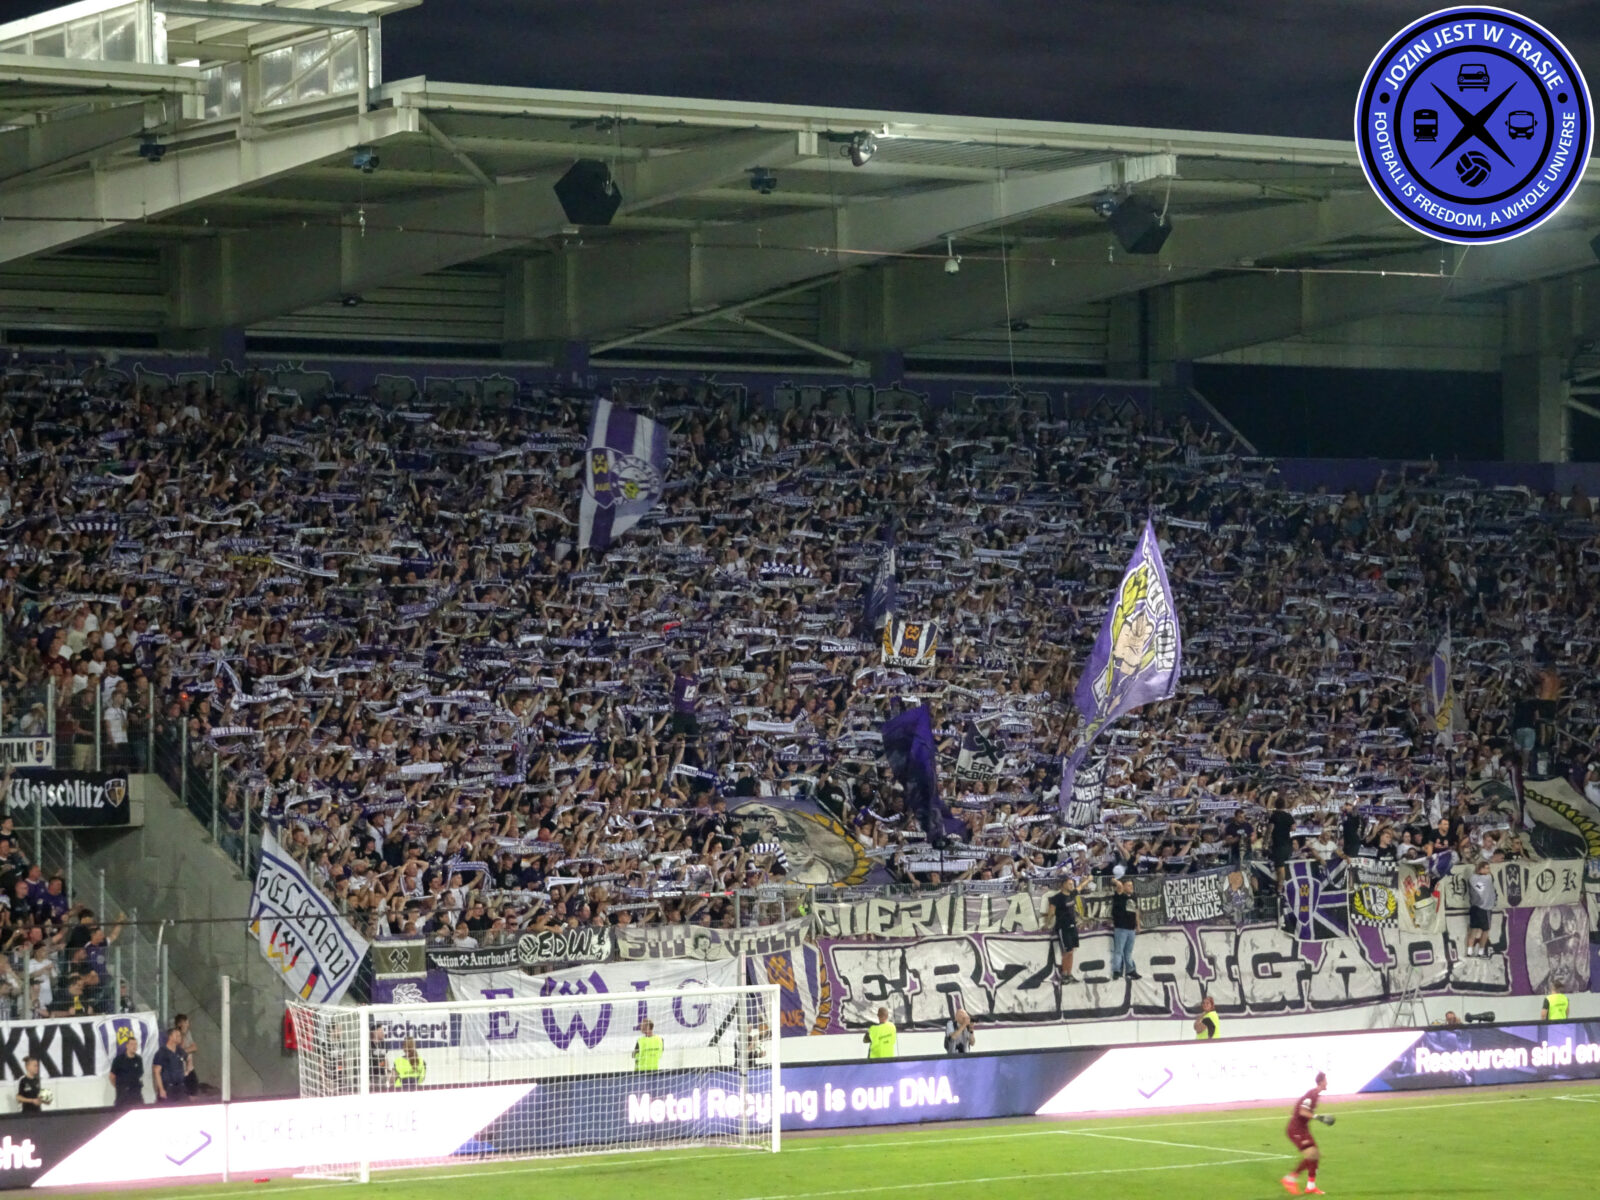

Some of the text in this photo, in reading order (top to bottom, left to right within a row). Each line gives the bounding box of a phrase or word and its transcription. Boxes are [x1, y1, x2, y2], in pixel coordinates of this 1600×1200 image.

[971, 762, 995, 774] ERZ
[1166, 874, 1217, 895] FREIHEIT
[1185, 890, 1220, 905] UNSERE
[1168, 901, 1223, 921] FREUNDE
[1415, 1037, 1600, 1074] Ressourcen sind en
[628, 1088, 700, 1124] Metal
[825, 1083, 850, 1113] is
[851, 1085, 895, 1111] our
[900, 1075, 960, 1107] DNA.
[0, 1136, 43, 1170] ht.
